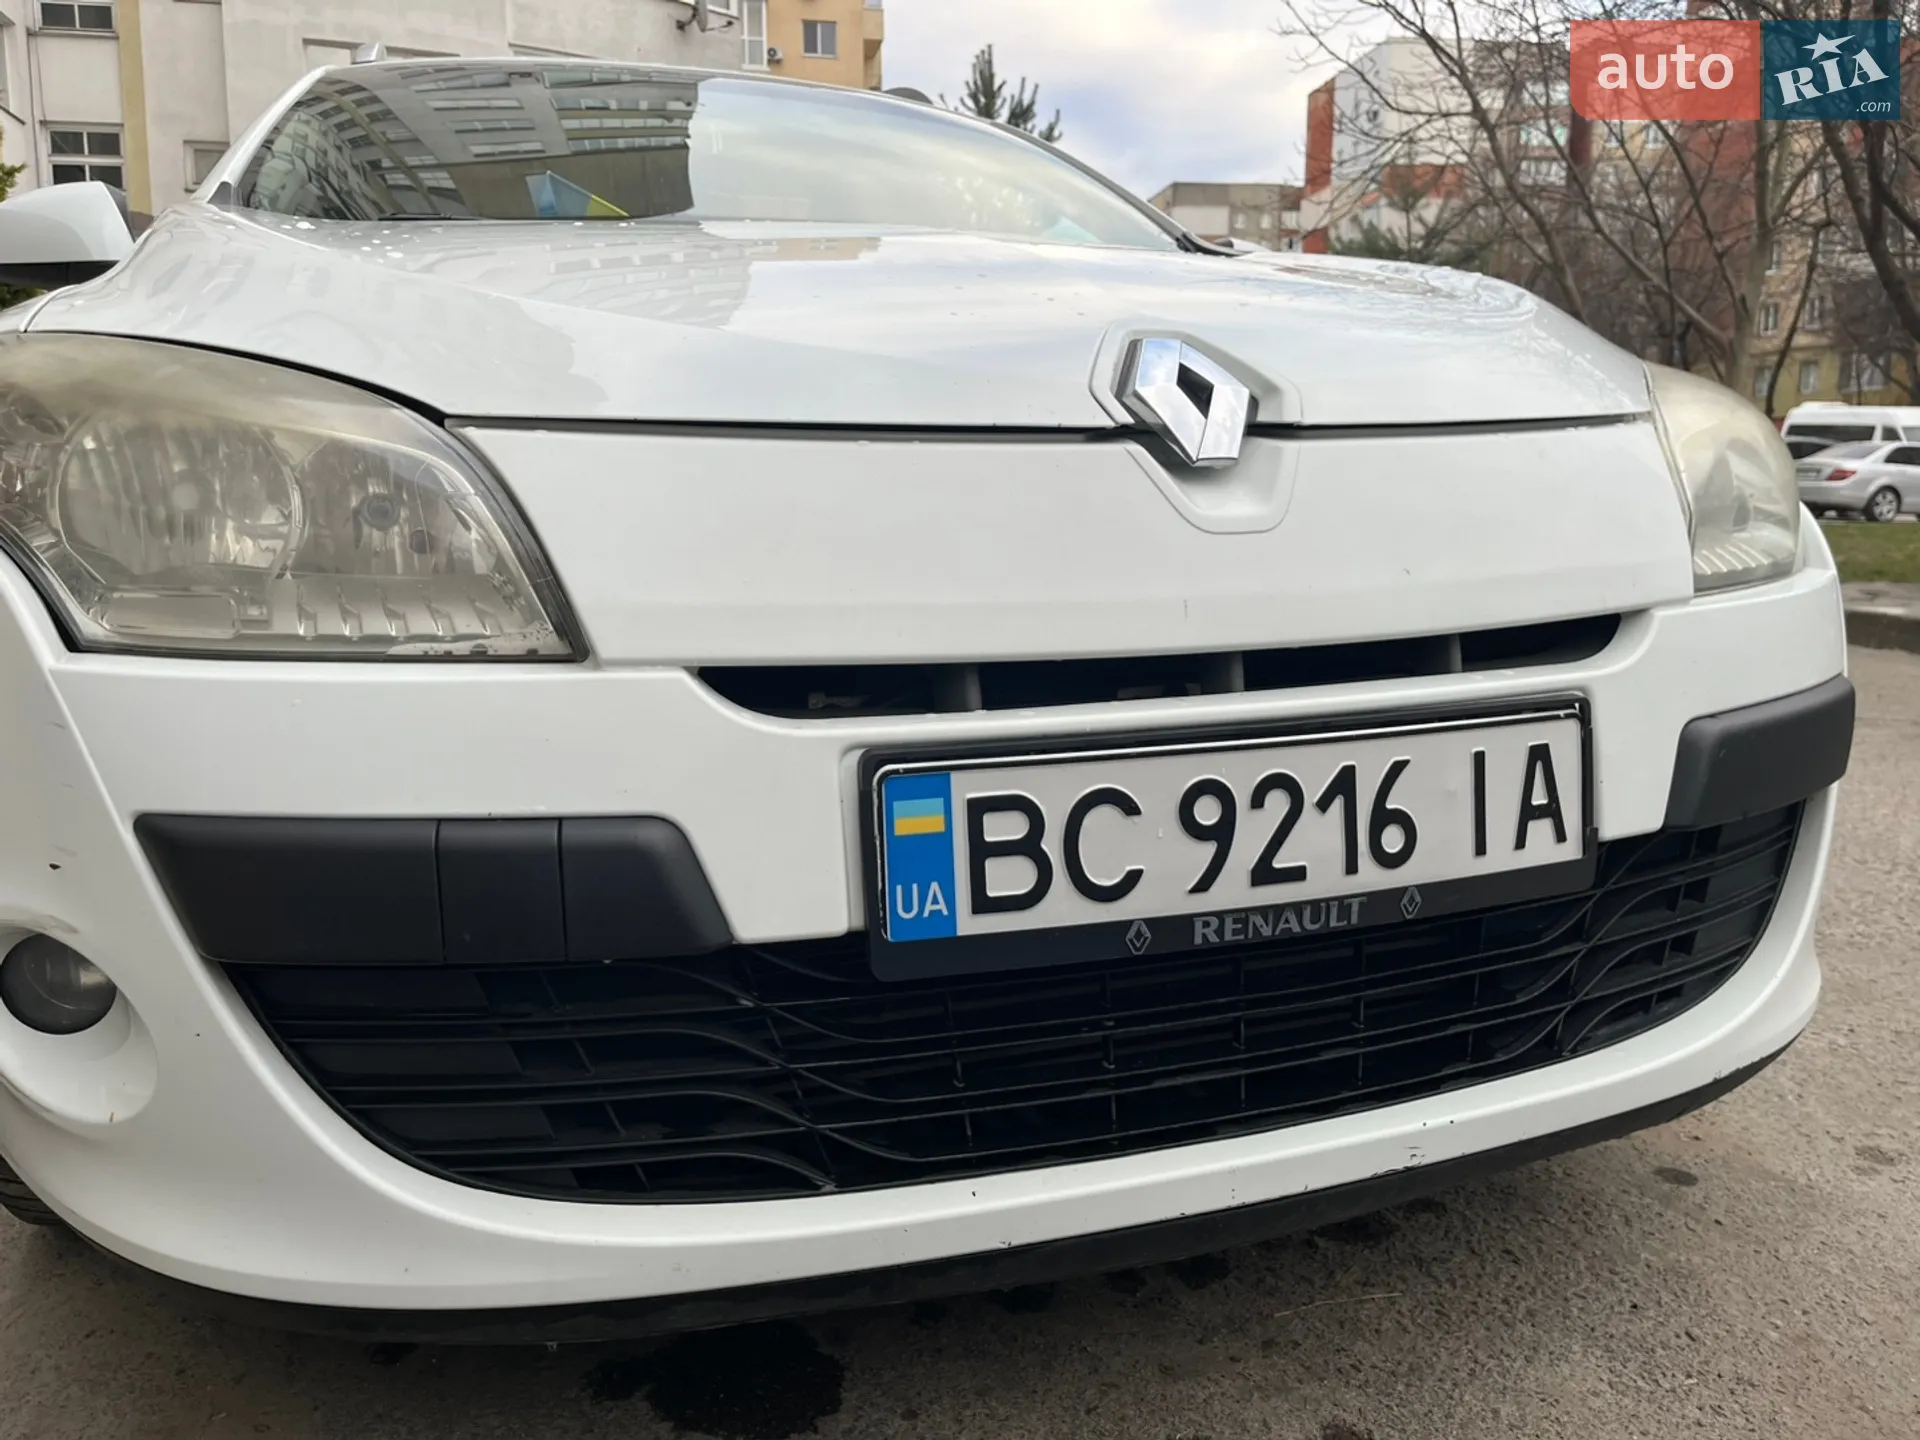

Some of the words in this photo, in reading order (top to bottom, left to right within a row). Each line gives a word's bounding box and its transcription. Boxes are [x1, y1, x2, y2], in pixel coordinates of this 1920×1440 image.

[966, 785, 1145, 915] BC
[1178, 757, 1418, 894] 9216
[1471, 742, 1568, 858] IA
[895, 881, 949, 922] UA
[1193, 896, 1367, 945] RENAULT
